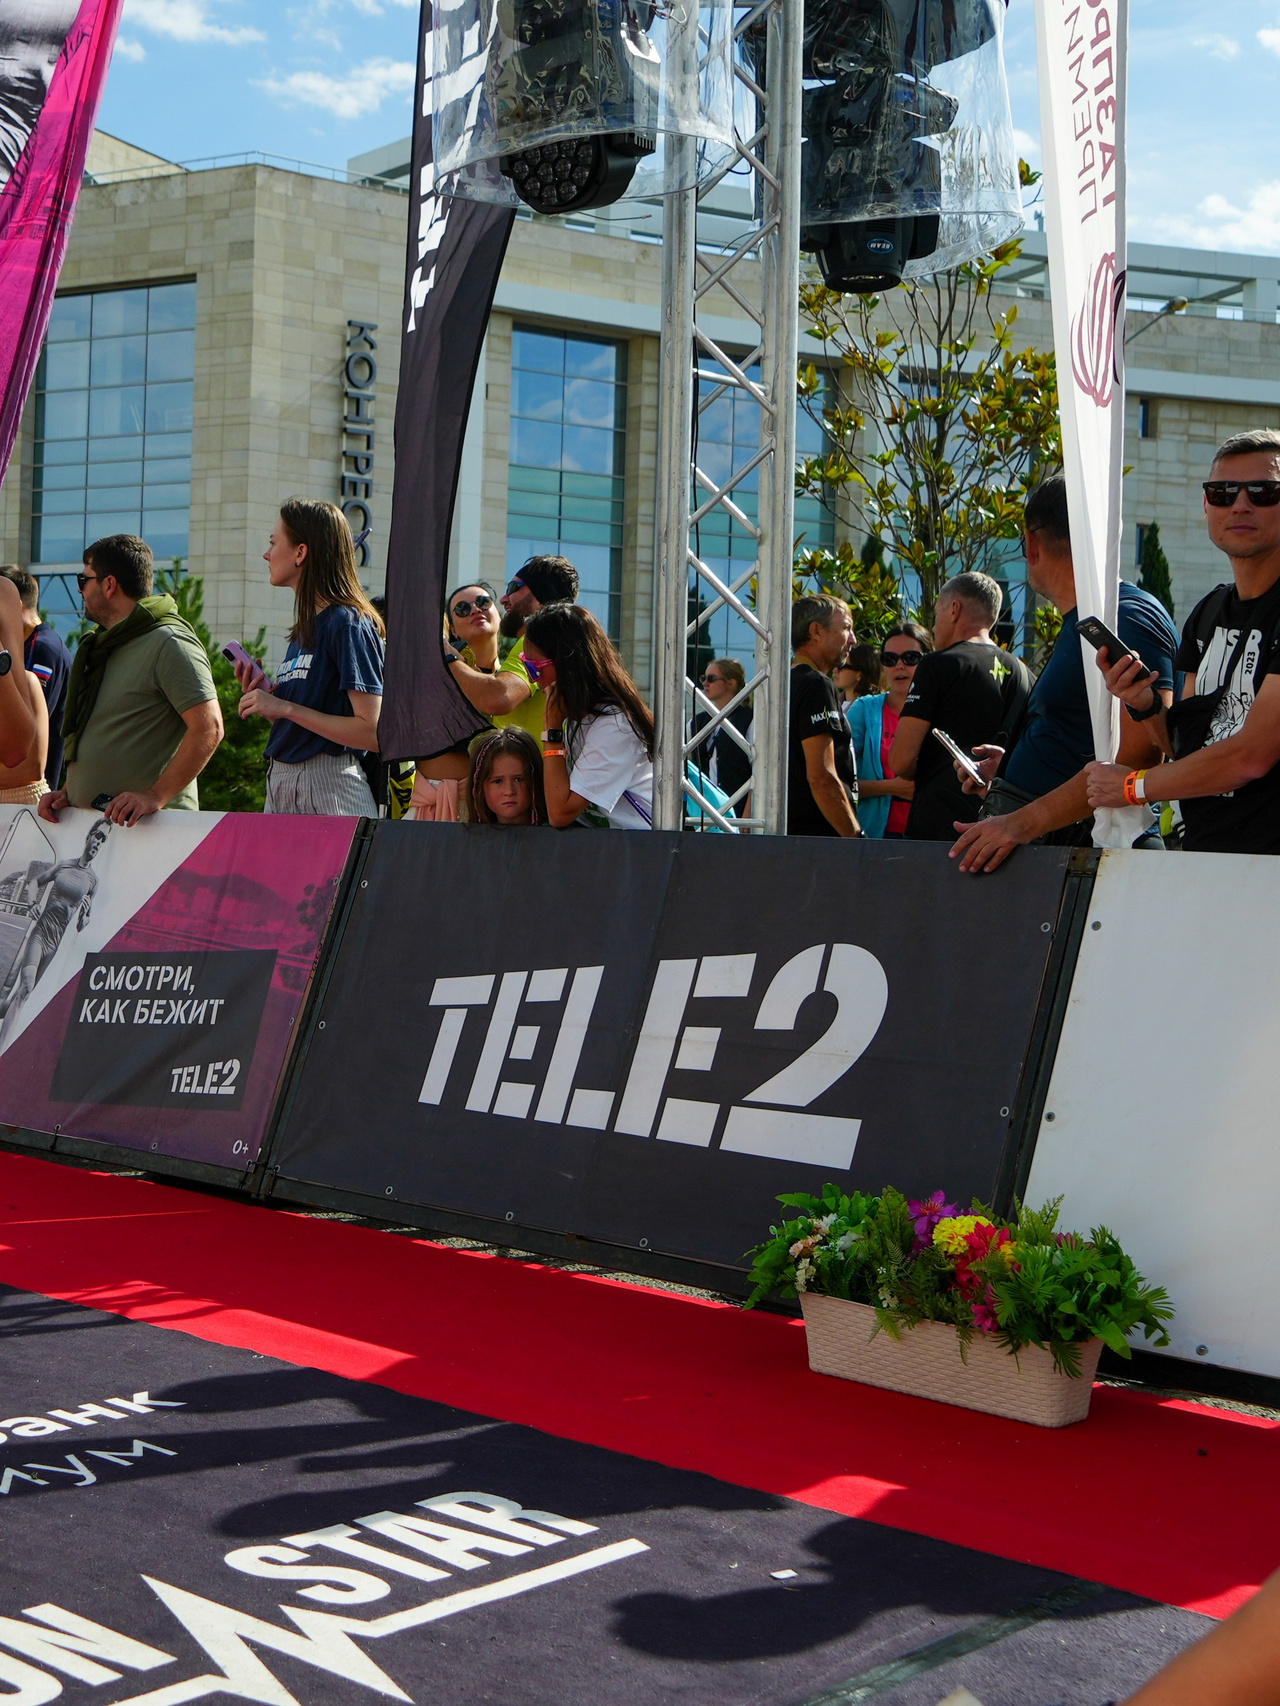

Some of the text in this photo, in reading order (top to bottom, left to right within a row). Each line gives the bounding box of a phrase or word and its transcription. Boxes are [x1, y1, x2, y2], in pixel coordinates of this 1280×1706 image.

[870, 242, 891, 250] BEAM
[1245, 651, 1256, 675] 2023
[88, 965, 196, 996] СМОТРИ,
[78, 998, 225, 1026] КАК БЕЖИТ
[418, 942, 890, 1171] TELE2
[170, 1058, 241, 1095] TELE2
[232, 1139, 249, 1155] 0+
[224, 1490, 600, 1606] STAR
